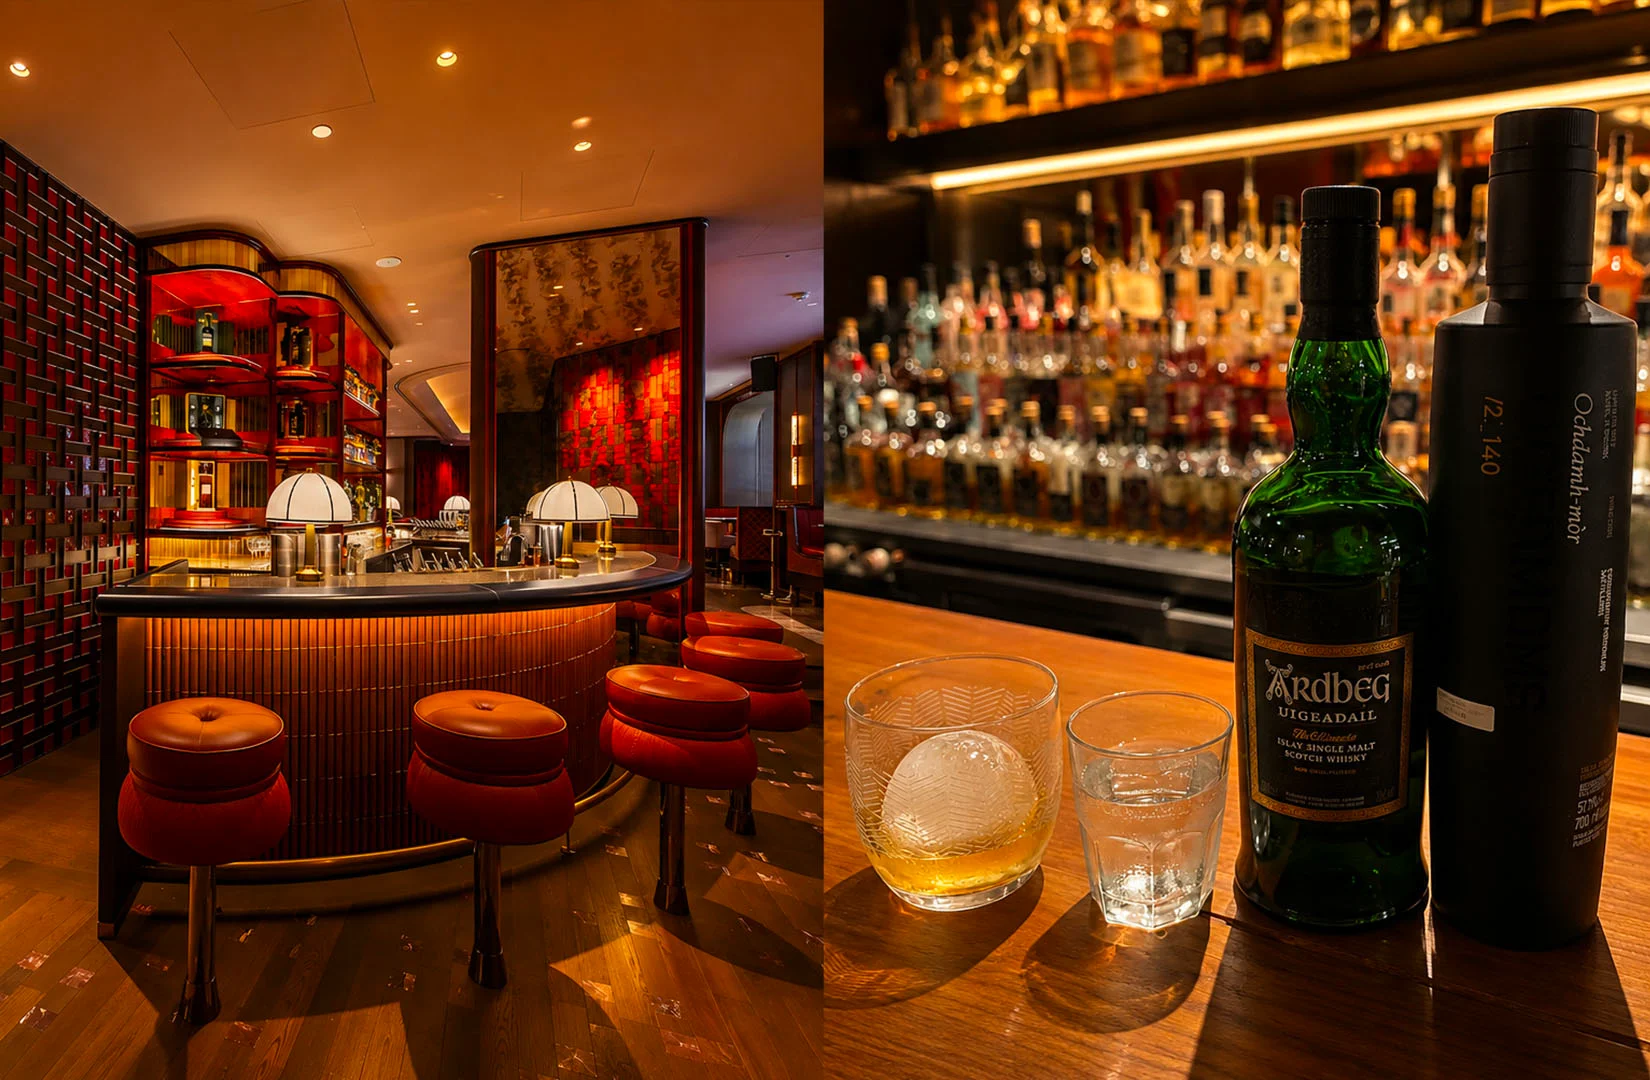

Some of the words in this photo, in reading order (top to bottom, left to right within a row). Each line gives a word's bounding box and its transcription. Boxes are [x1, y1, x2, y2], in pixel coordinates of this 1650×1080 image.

[1567, 392, 1594, 545] Ochdamh-mòr
[1278, 706, 1377, 723] UIGEADAIL
[1277, 737, 1303, 750] ISLAY
[1306, 743, 1344, 753] SINGLE
[1346, 741, 1376, 753] MALT
[1284, 750, 1323, 763] SCOTCH
[1326, 753, 1368, 763] WHISKY
